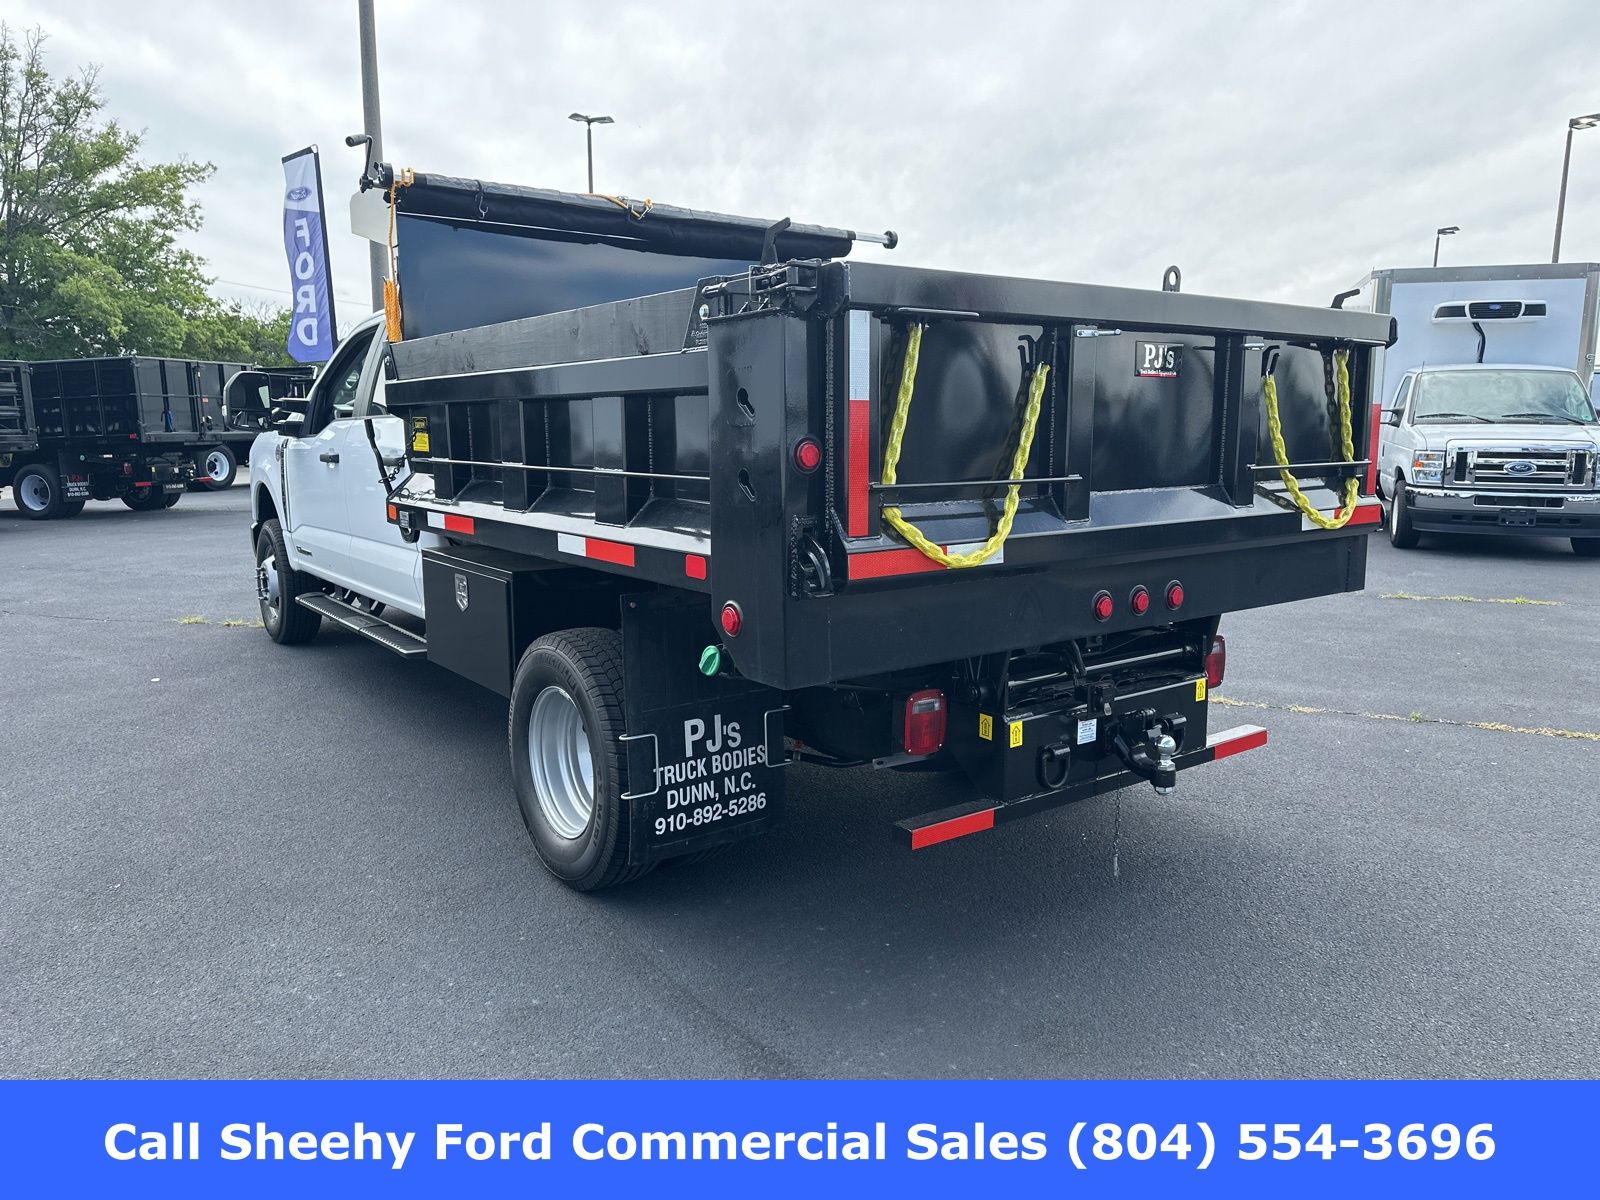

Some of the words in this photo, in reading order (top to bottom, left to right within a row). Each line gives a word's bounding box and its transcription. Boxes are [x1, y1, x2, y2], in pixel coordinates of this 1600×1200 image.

[653, 757, 708, 787] TRUCK
[711, 744, 766, 774] BODIES
[666, 780, 720, 810] DUNN,
[724, 771, 756, 795] N.C.
[654, 792, 767, 836] 910-892-5286
